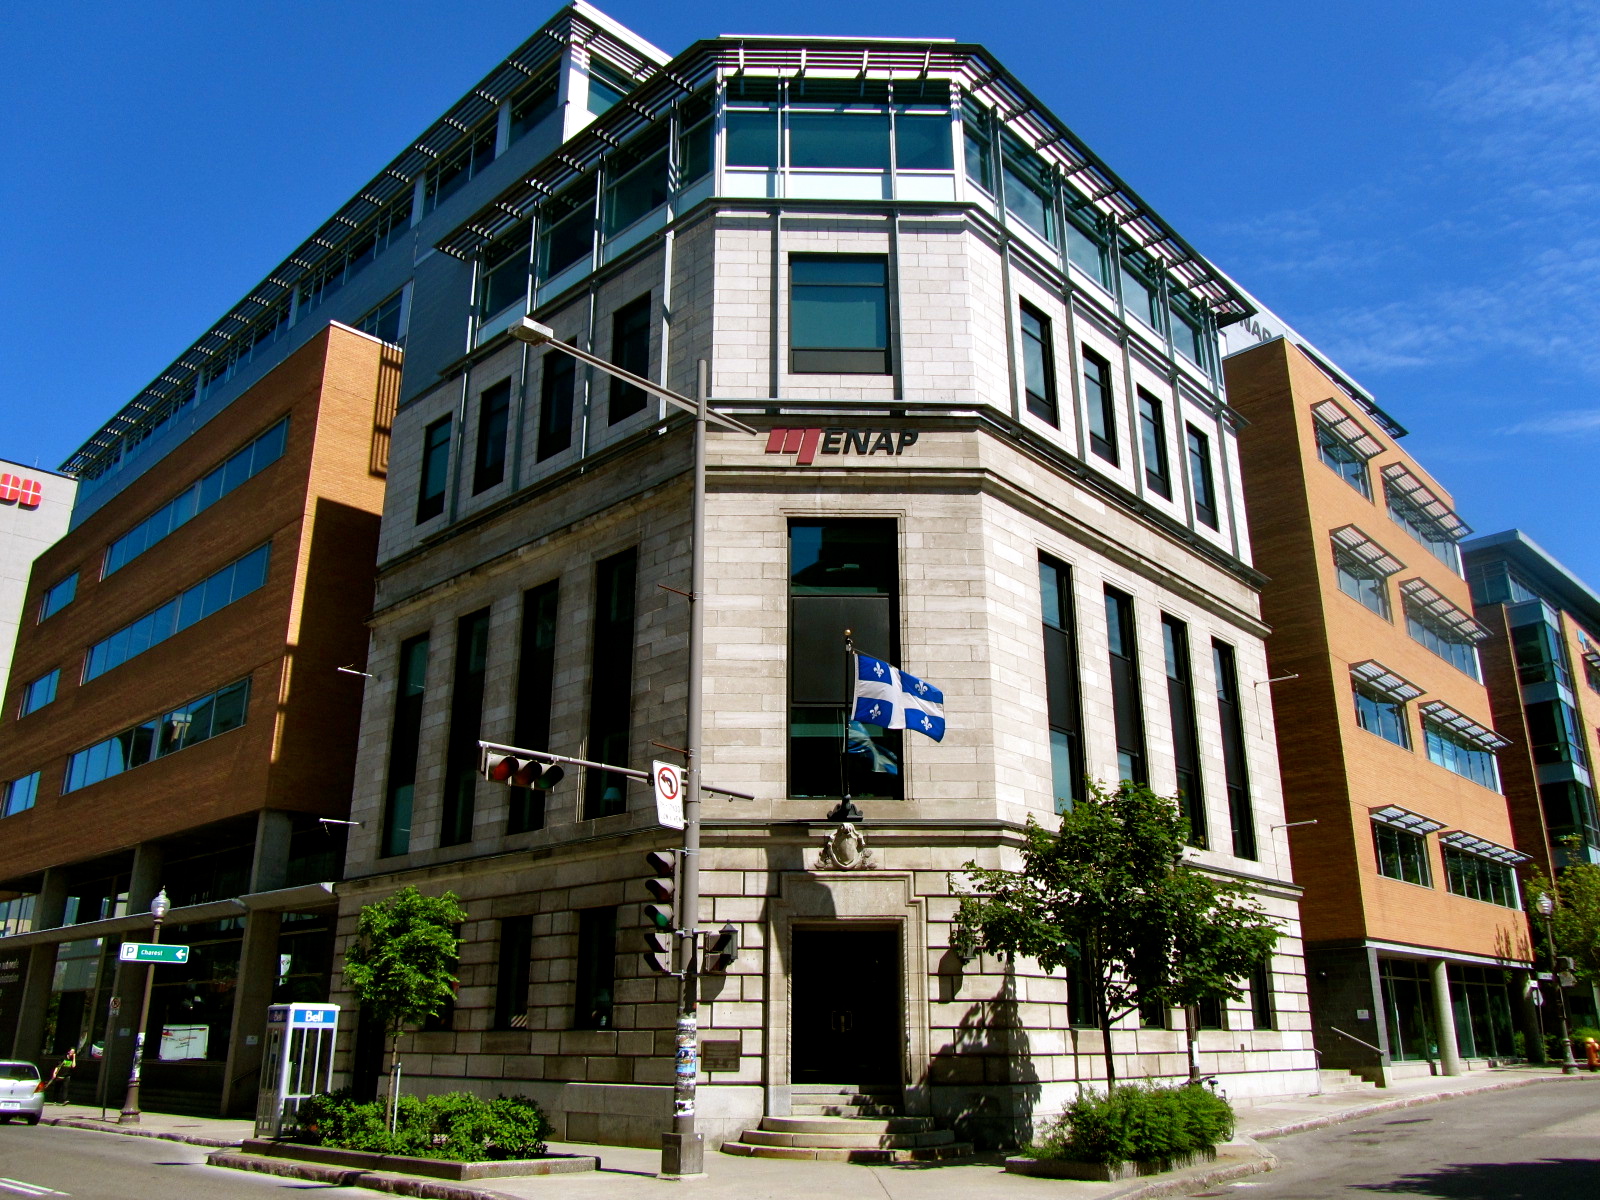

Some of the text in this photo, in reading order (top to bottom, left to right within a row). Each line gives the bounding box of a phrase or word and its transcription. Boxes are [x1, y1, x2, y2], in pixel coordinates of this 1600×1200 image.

[821, 428, 919, 455] ENAP
[126, 946, 135, 957] P
[305, 1010, 324, 1022] Bell
